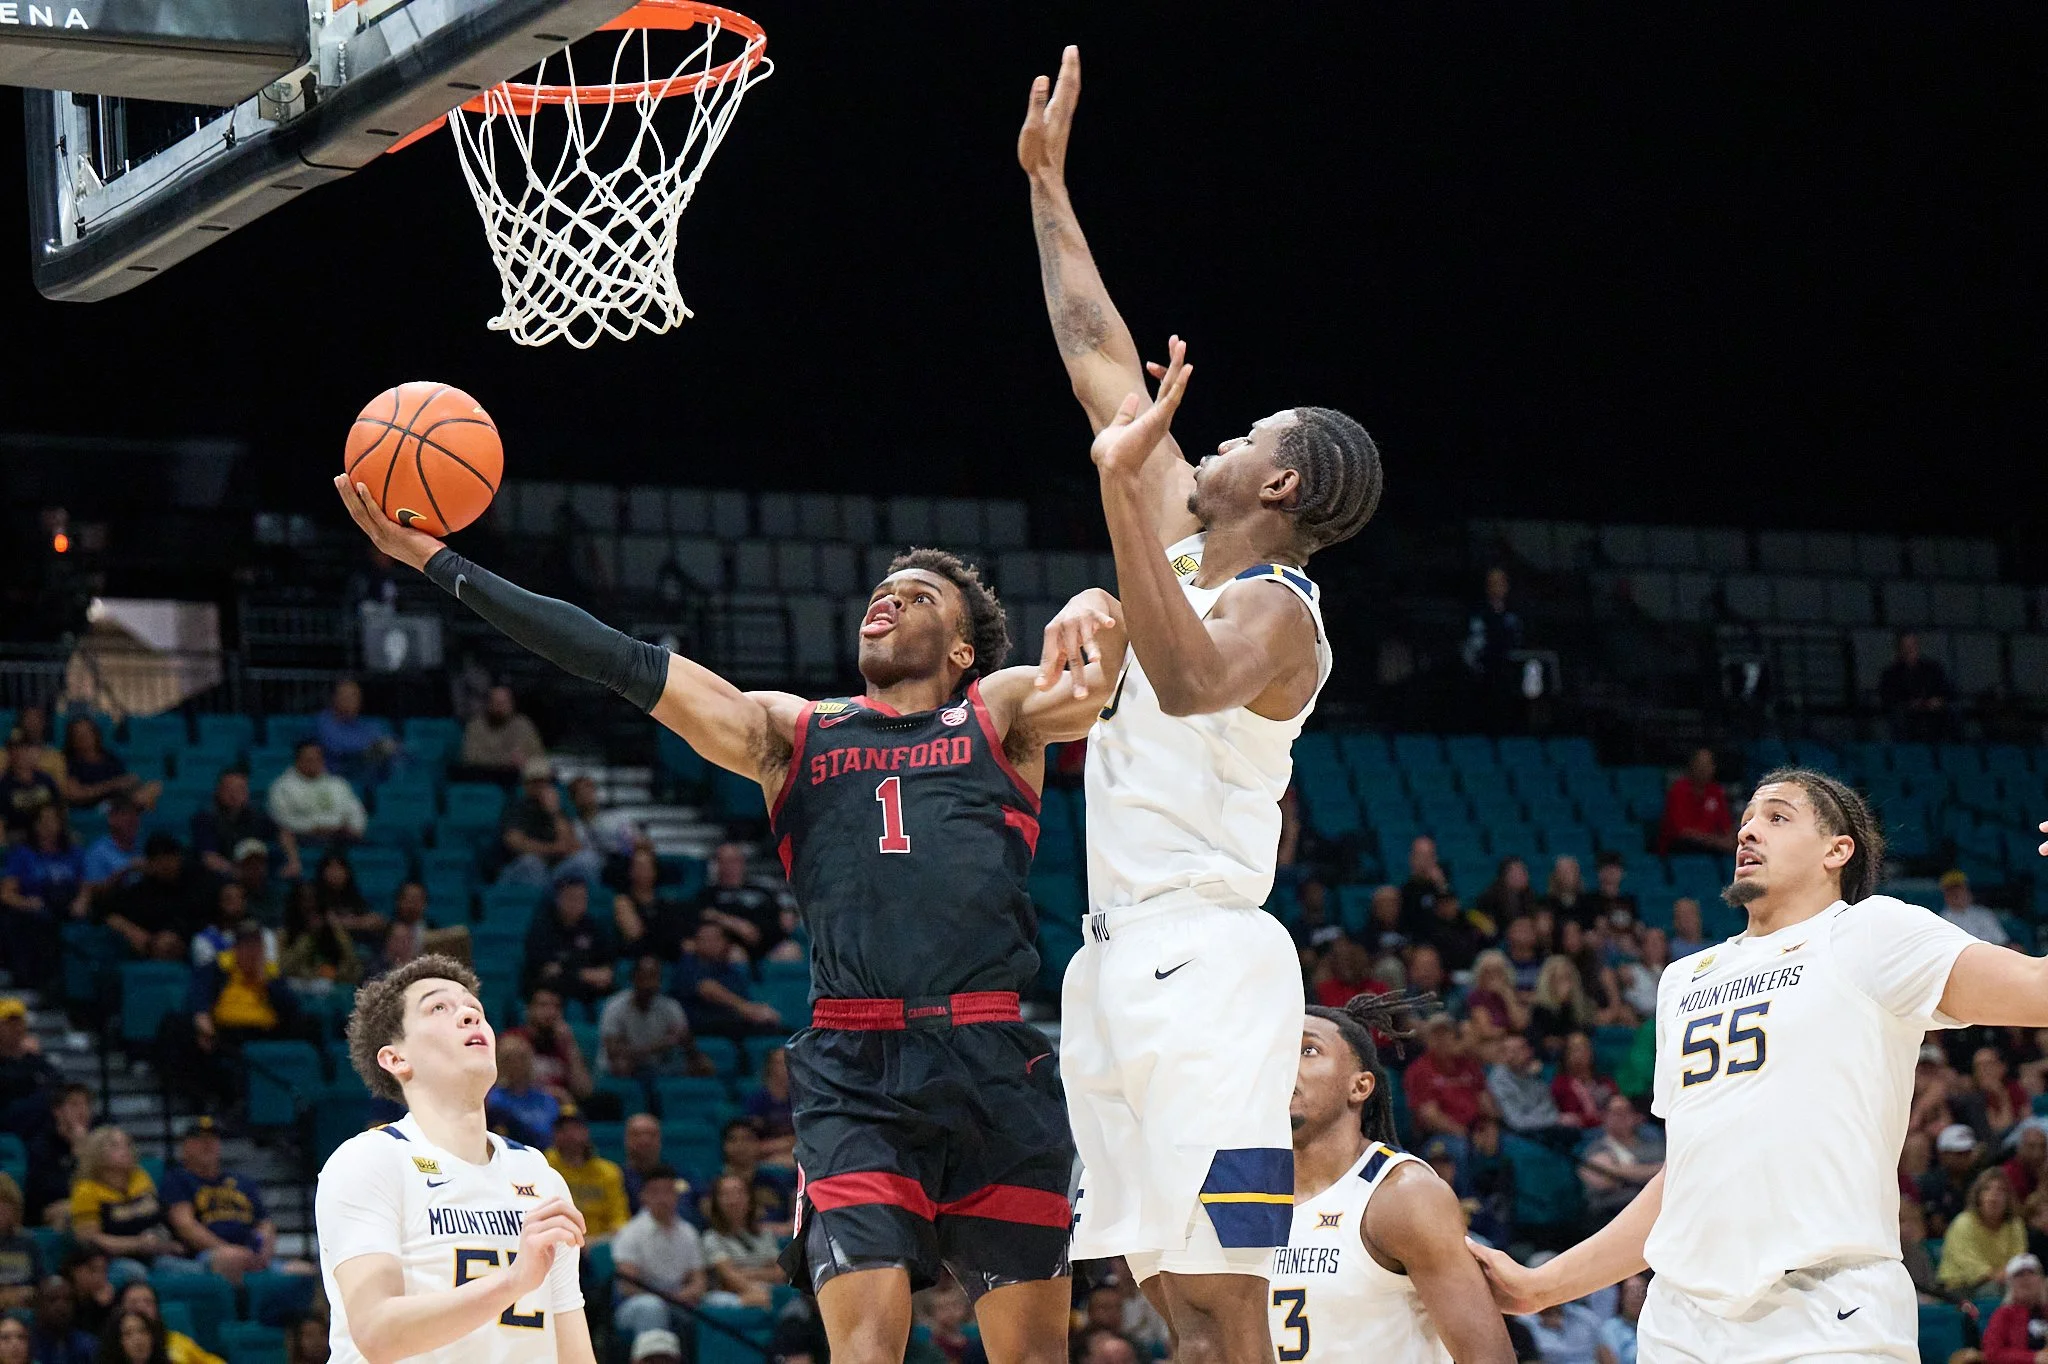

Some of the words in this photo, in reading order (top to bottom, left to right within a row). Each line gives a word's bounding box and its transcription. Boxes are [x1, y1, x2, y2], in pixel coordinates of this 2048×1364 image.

[810, 735, 972, 785] STANFORD
[875, 776, 911, 854] 1
[1676, 965, 1804, 1018] MOUNTAINEERS
[1681, 1000, 1772, 1089] 55
[1316, 1211, 1343, 1229] XII
[1272, 1286, 1311, 1364] 3
